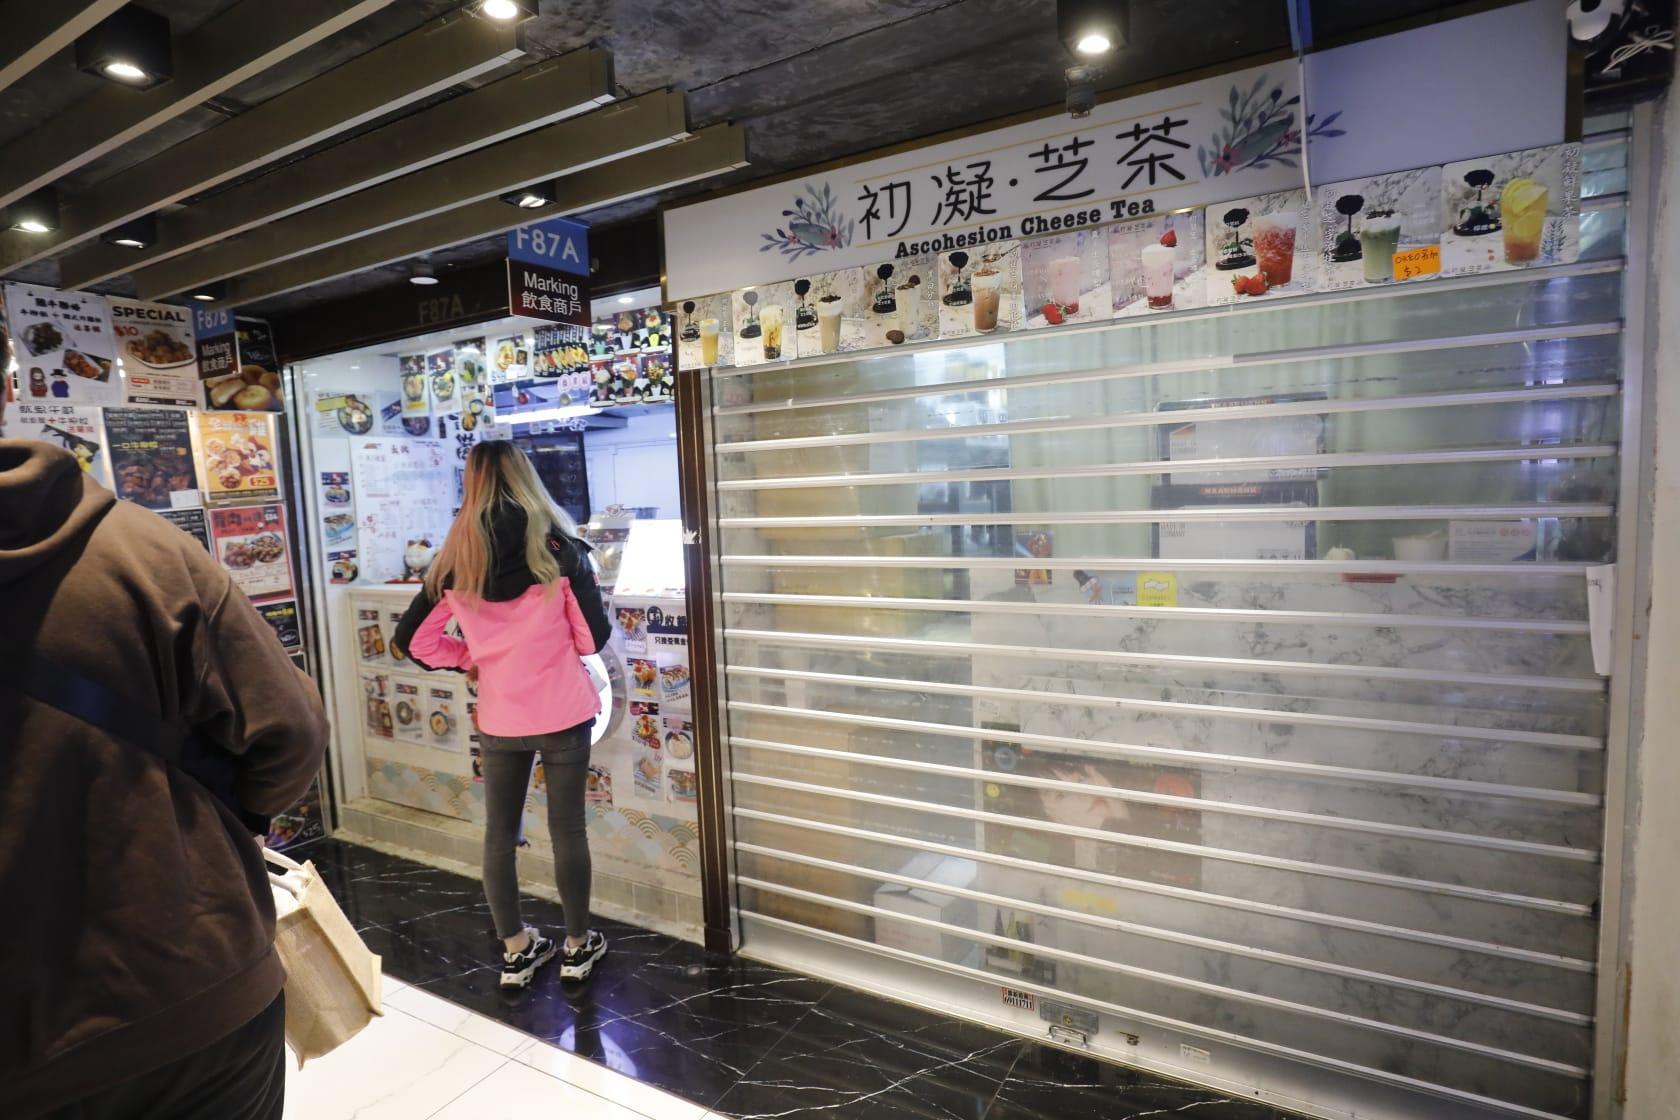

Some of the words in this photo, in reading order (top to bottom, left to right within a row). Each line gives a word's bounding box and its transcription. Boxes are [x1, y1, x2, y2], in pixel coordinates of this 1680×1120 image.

[894, 222, 1012, 257] Ascohesion
[1021, 207, 1103, 236] Cheese
[1109, 196, 1155, 222] Tea
[515, 225, 580, 263] F87A
[524, 271, 579, 300] Marking
[112, 305, 186, 322] SPECIAL
[521, 290, 582, 316] 飲食商戶
